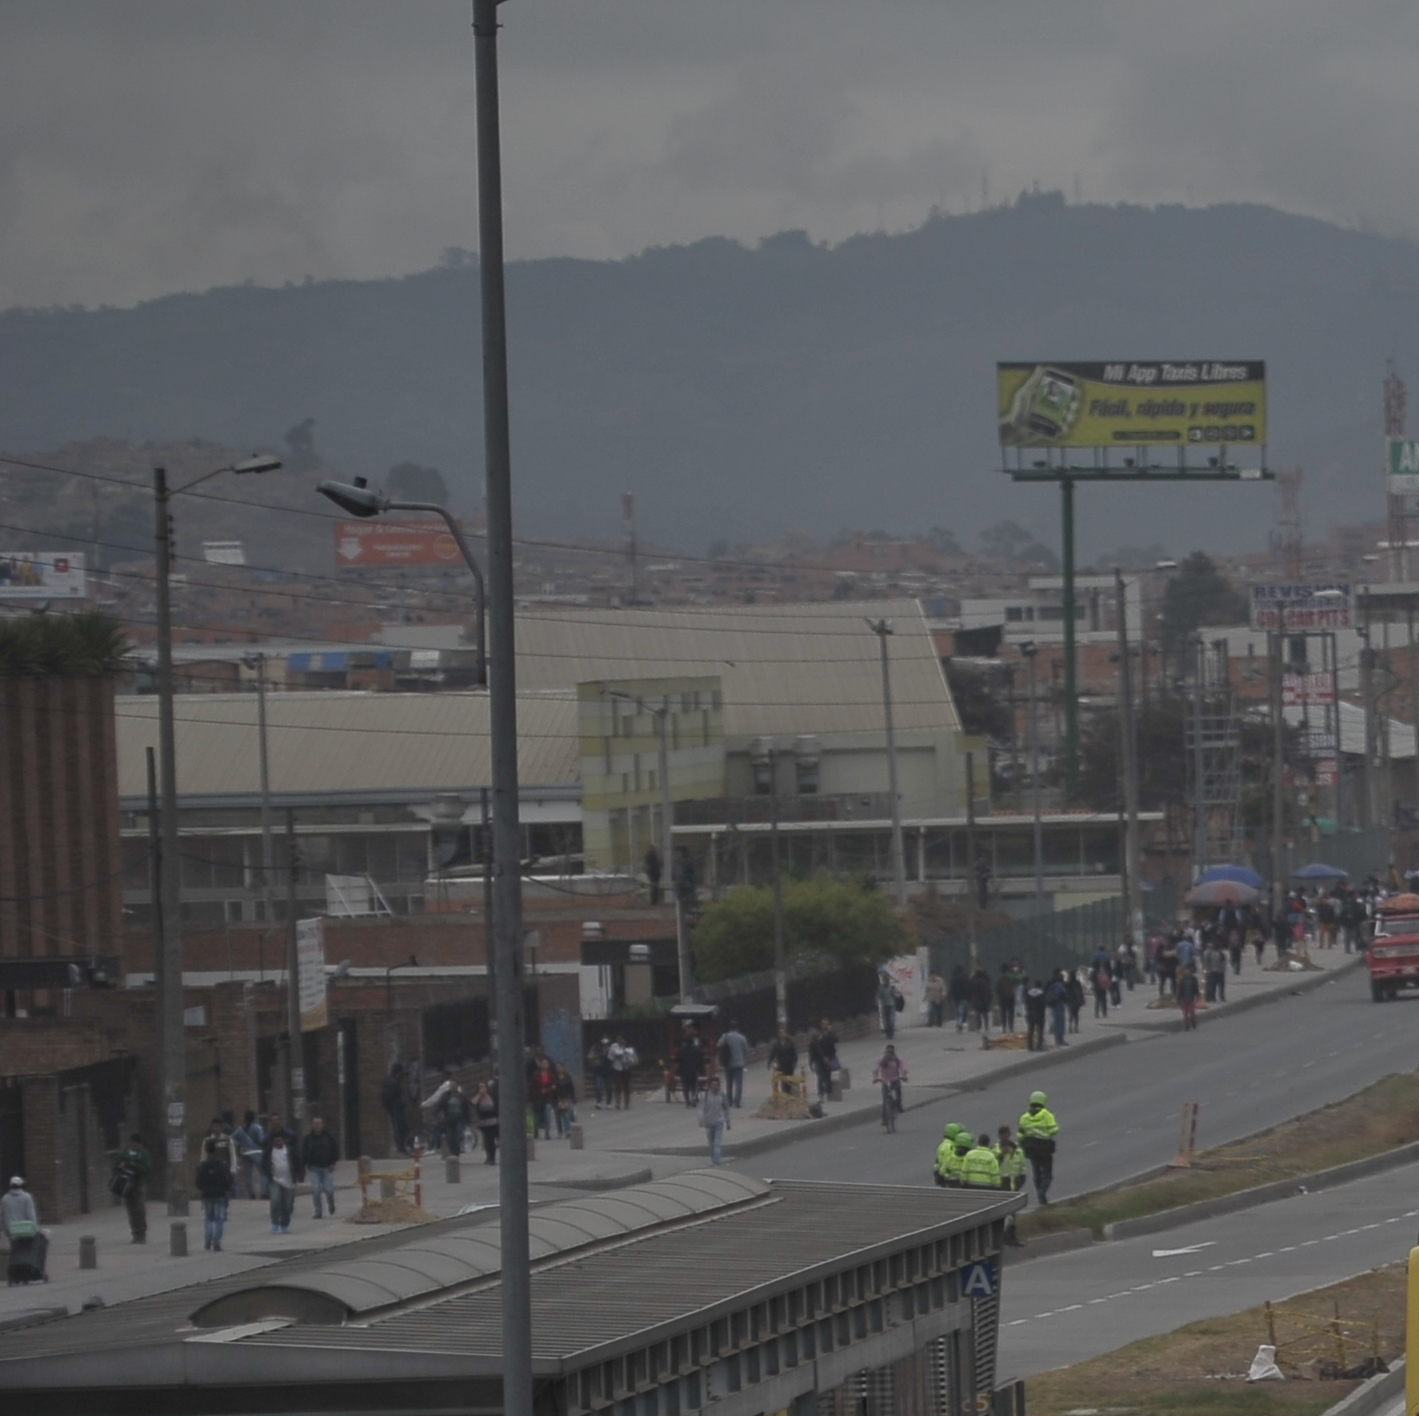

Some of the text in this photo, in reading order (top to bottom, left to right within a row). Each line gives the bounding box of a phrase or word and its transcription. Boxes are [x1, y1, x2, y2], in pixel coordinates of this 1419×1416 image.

[1103, 363, 1248, 384] Mi App Taxis Libres
[1188, 401, 1200, 419] y
[963, 1264, 993, 1296] A
